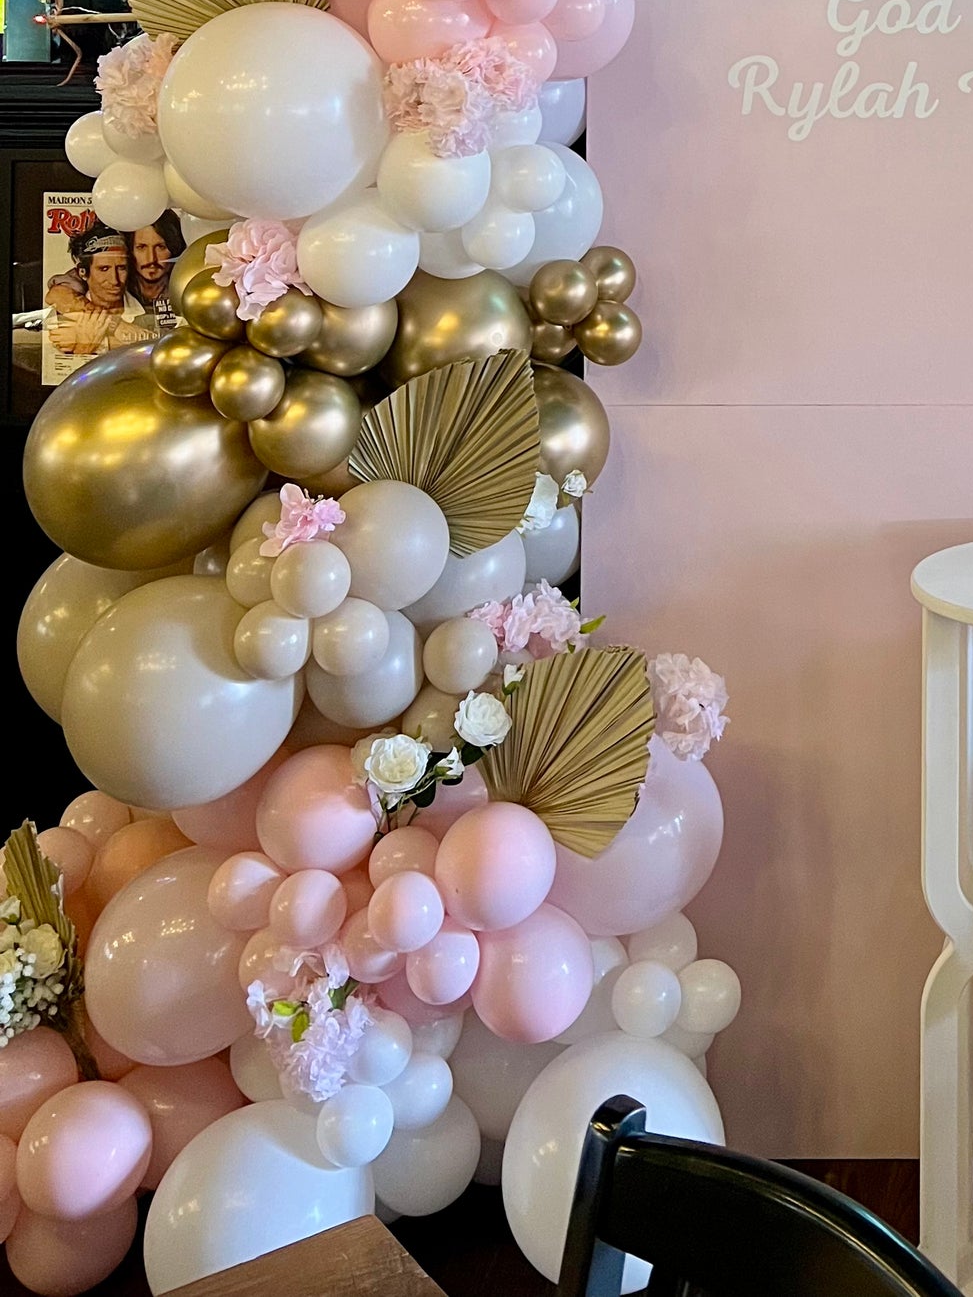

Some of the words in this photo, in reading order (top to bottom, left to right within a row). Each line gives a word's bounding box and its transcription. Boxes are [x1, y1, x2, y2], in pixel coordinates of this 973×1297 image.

[728, 54, 938, 142] Rylah
[48, 196, 87, 204] MAROON
[47, 208, 96, 239] Roll
